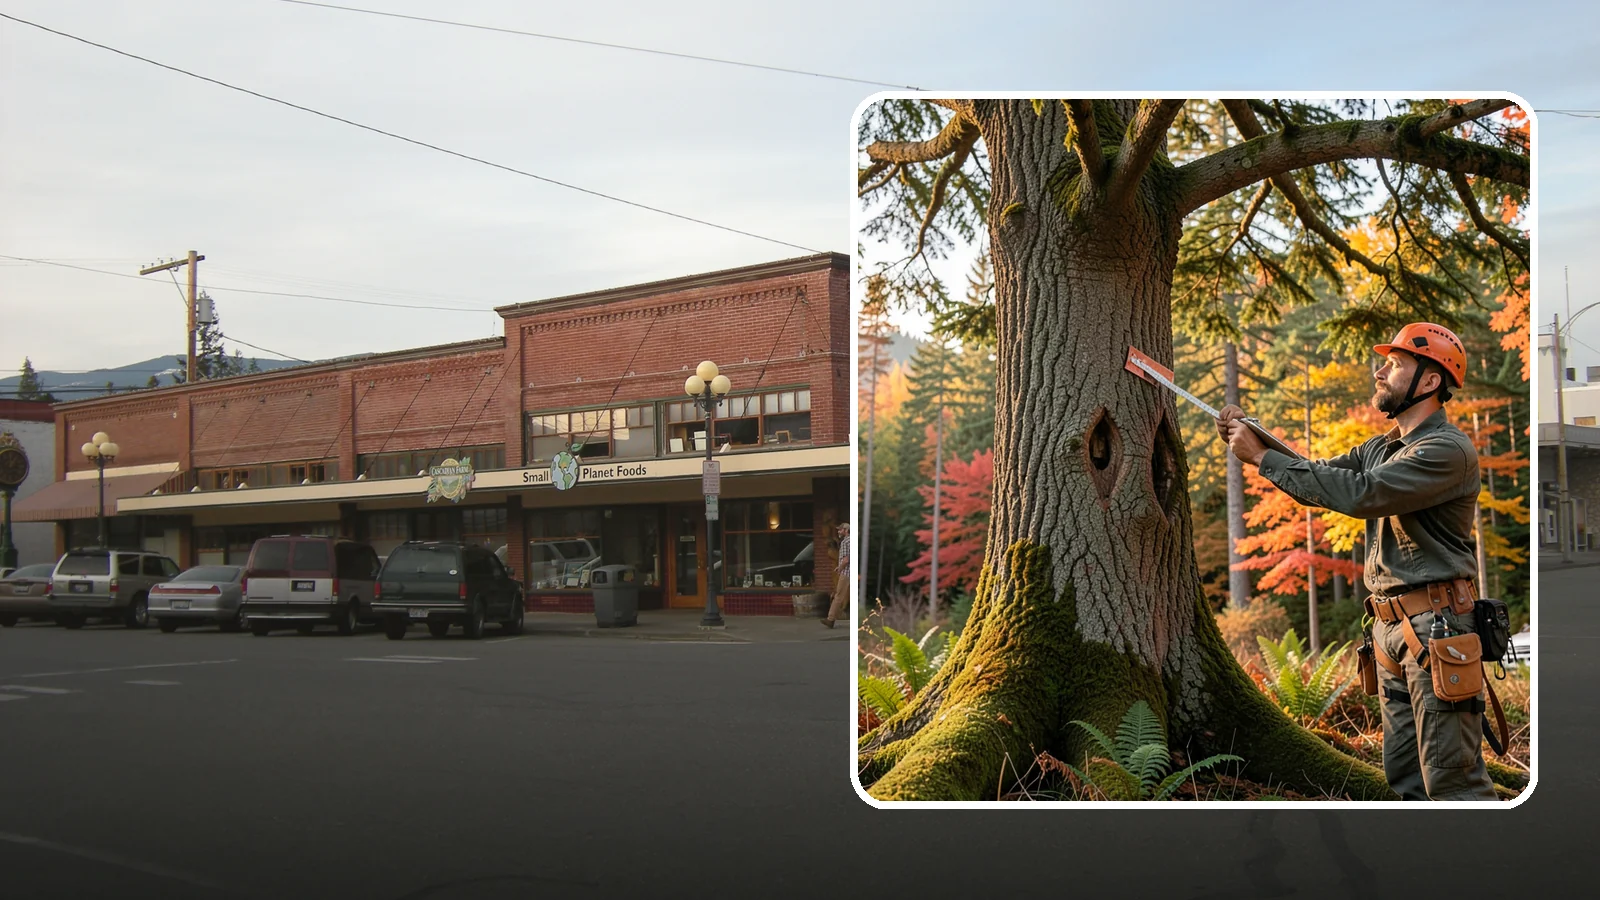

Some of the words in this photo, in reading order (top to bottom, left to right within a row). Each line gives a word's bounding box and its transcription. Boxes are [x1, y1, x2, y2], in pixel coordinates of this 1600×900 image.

[523, 471, 548, 483] Small
[583, 467, 614, 479] Planet
[617, 464, 647, 477] Foods
